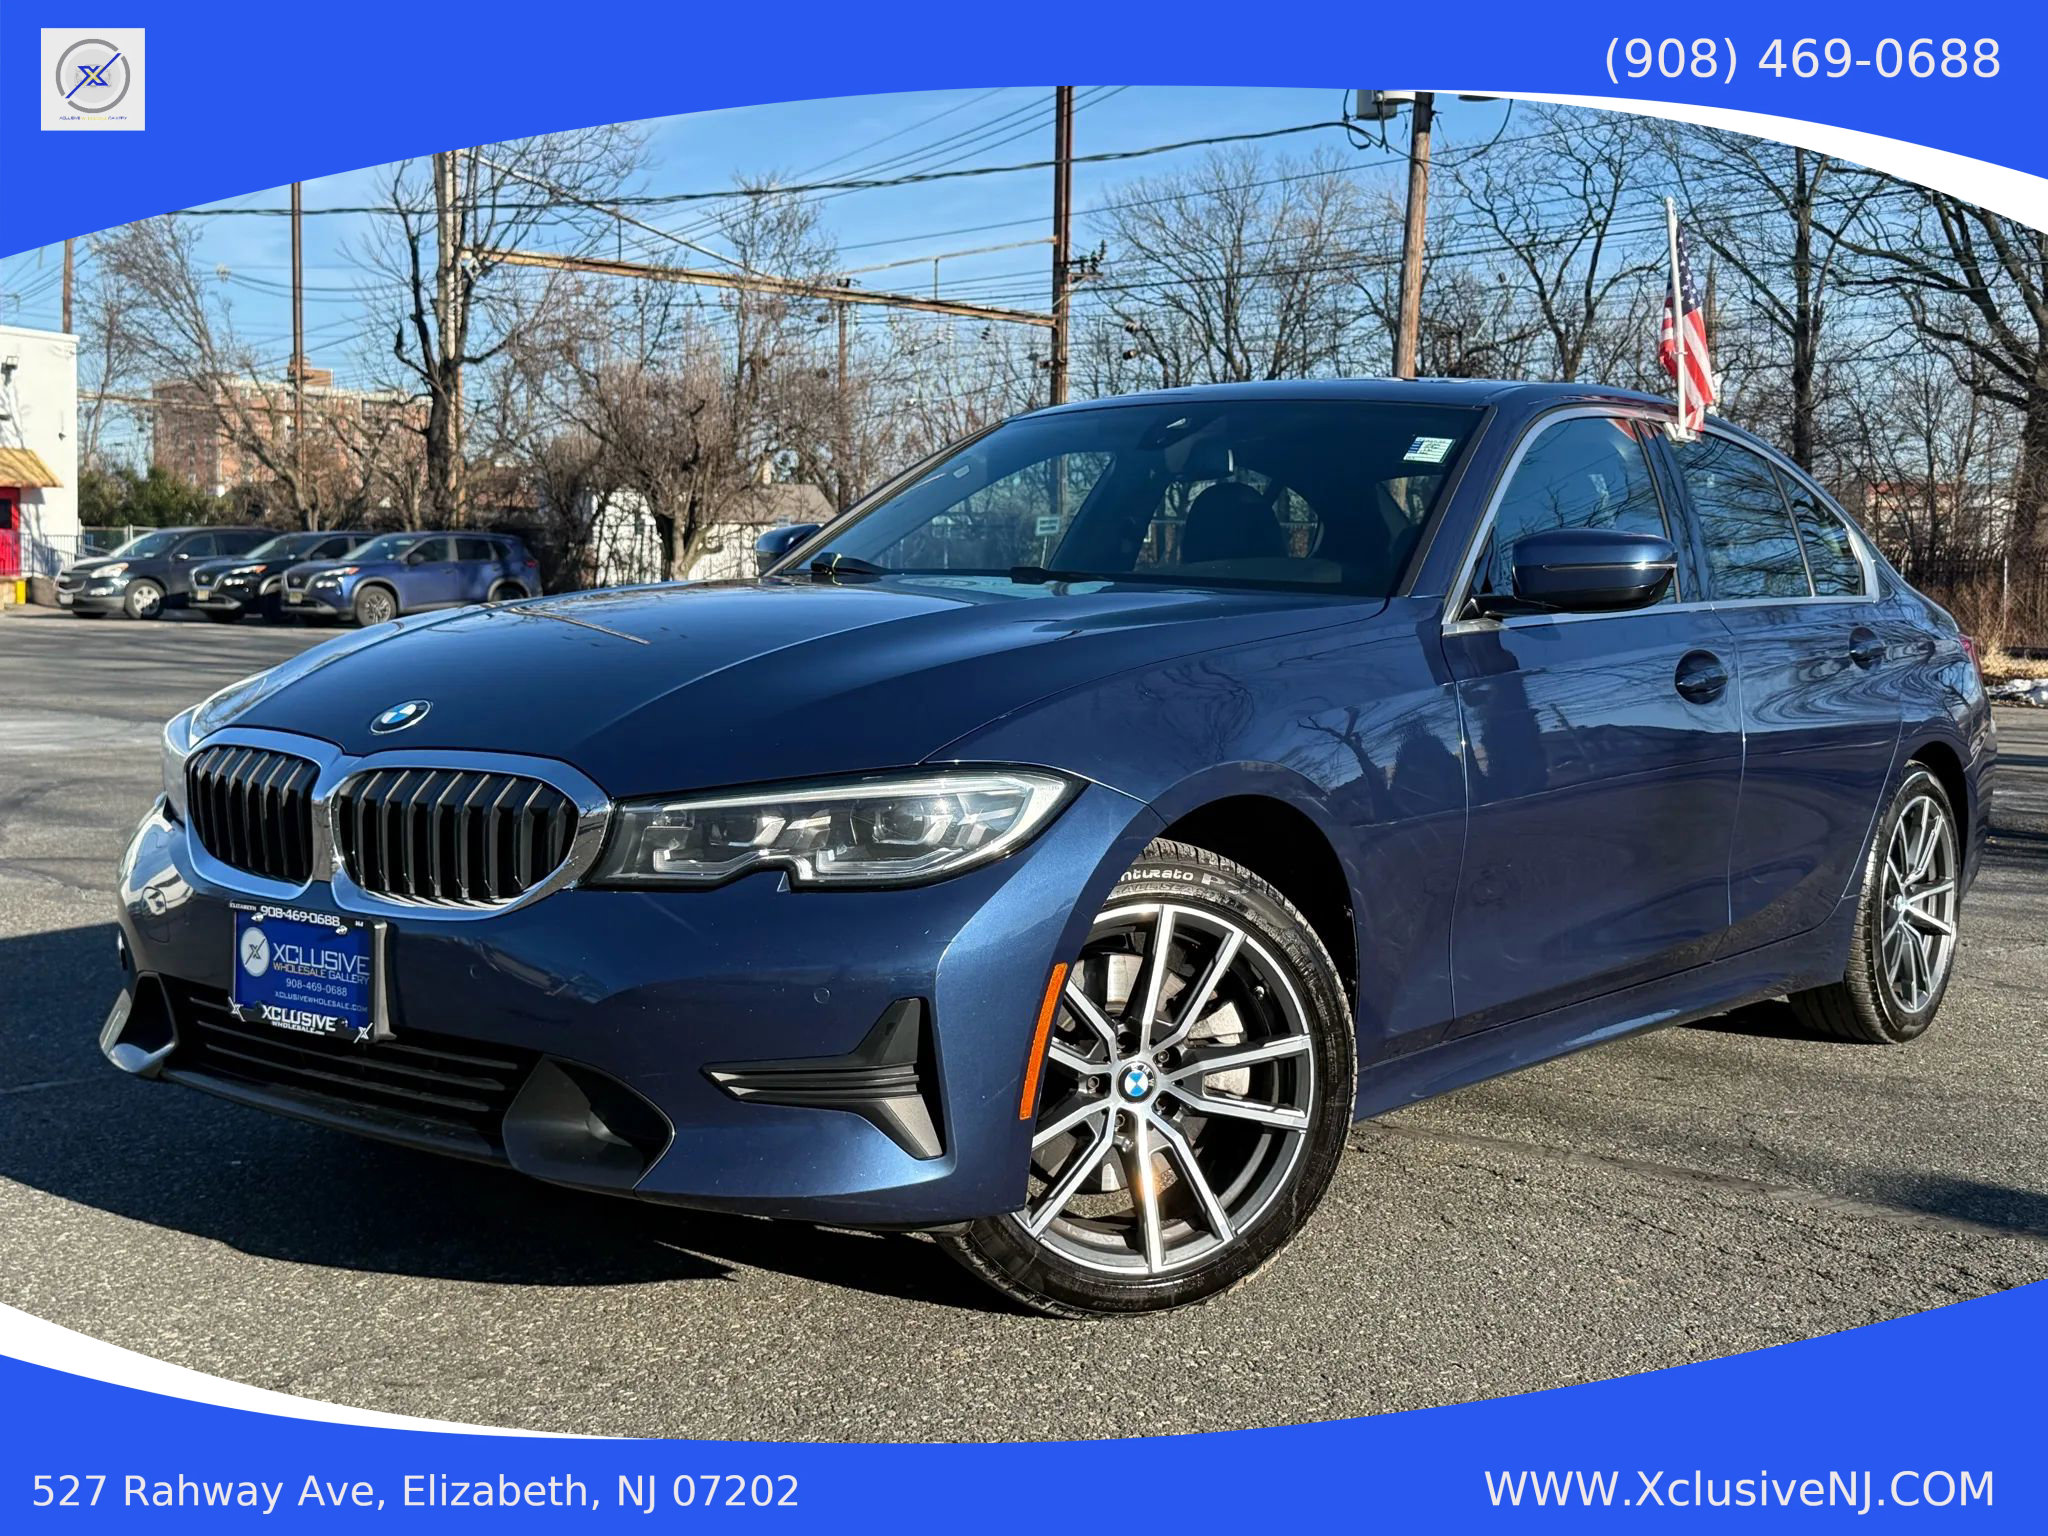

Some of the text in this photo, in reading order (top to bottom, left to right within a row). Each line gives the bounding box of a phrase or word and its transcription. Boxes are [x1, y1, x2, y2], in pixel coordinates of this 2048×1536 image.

[260, 905, 341, 927] 908-469-0688
[272, 943, 371, 976] XCLUSIVE
[272, 962, 370, 985] WHOLESALE GALLERY
[285, 978, 348, 997] 908-469-0688
[274, 990, 369, 1013] XCLUSIVEWHOLESALE.COM
[261, 1004, 338, 1032] XCLUSIVE
